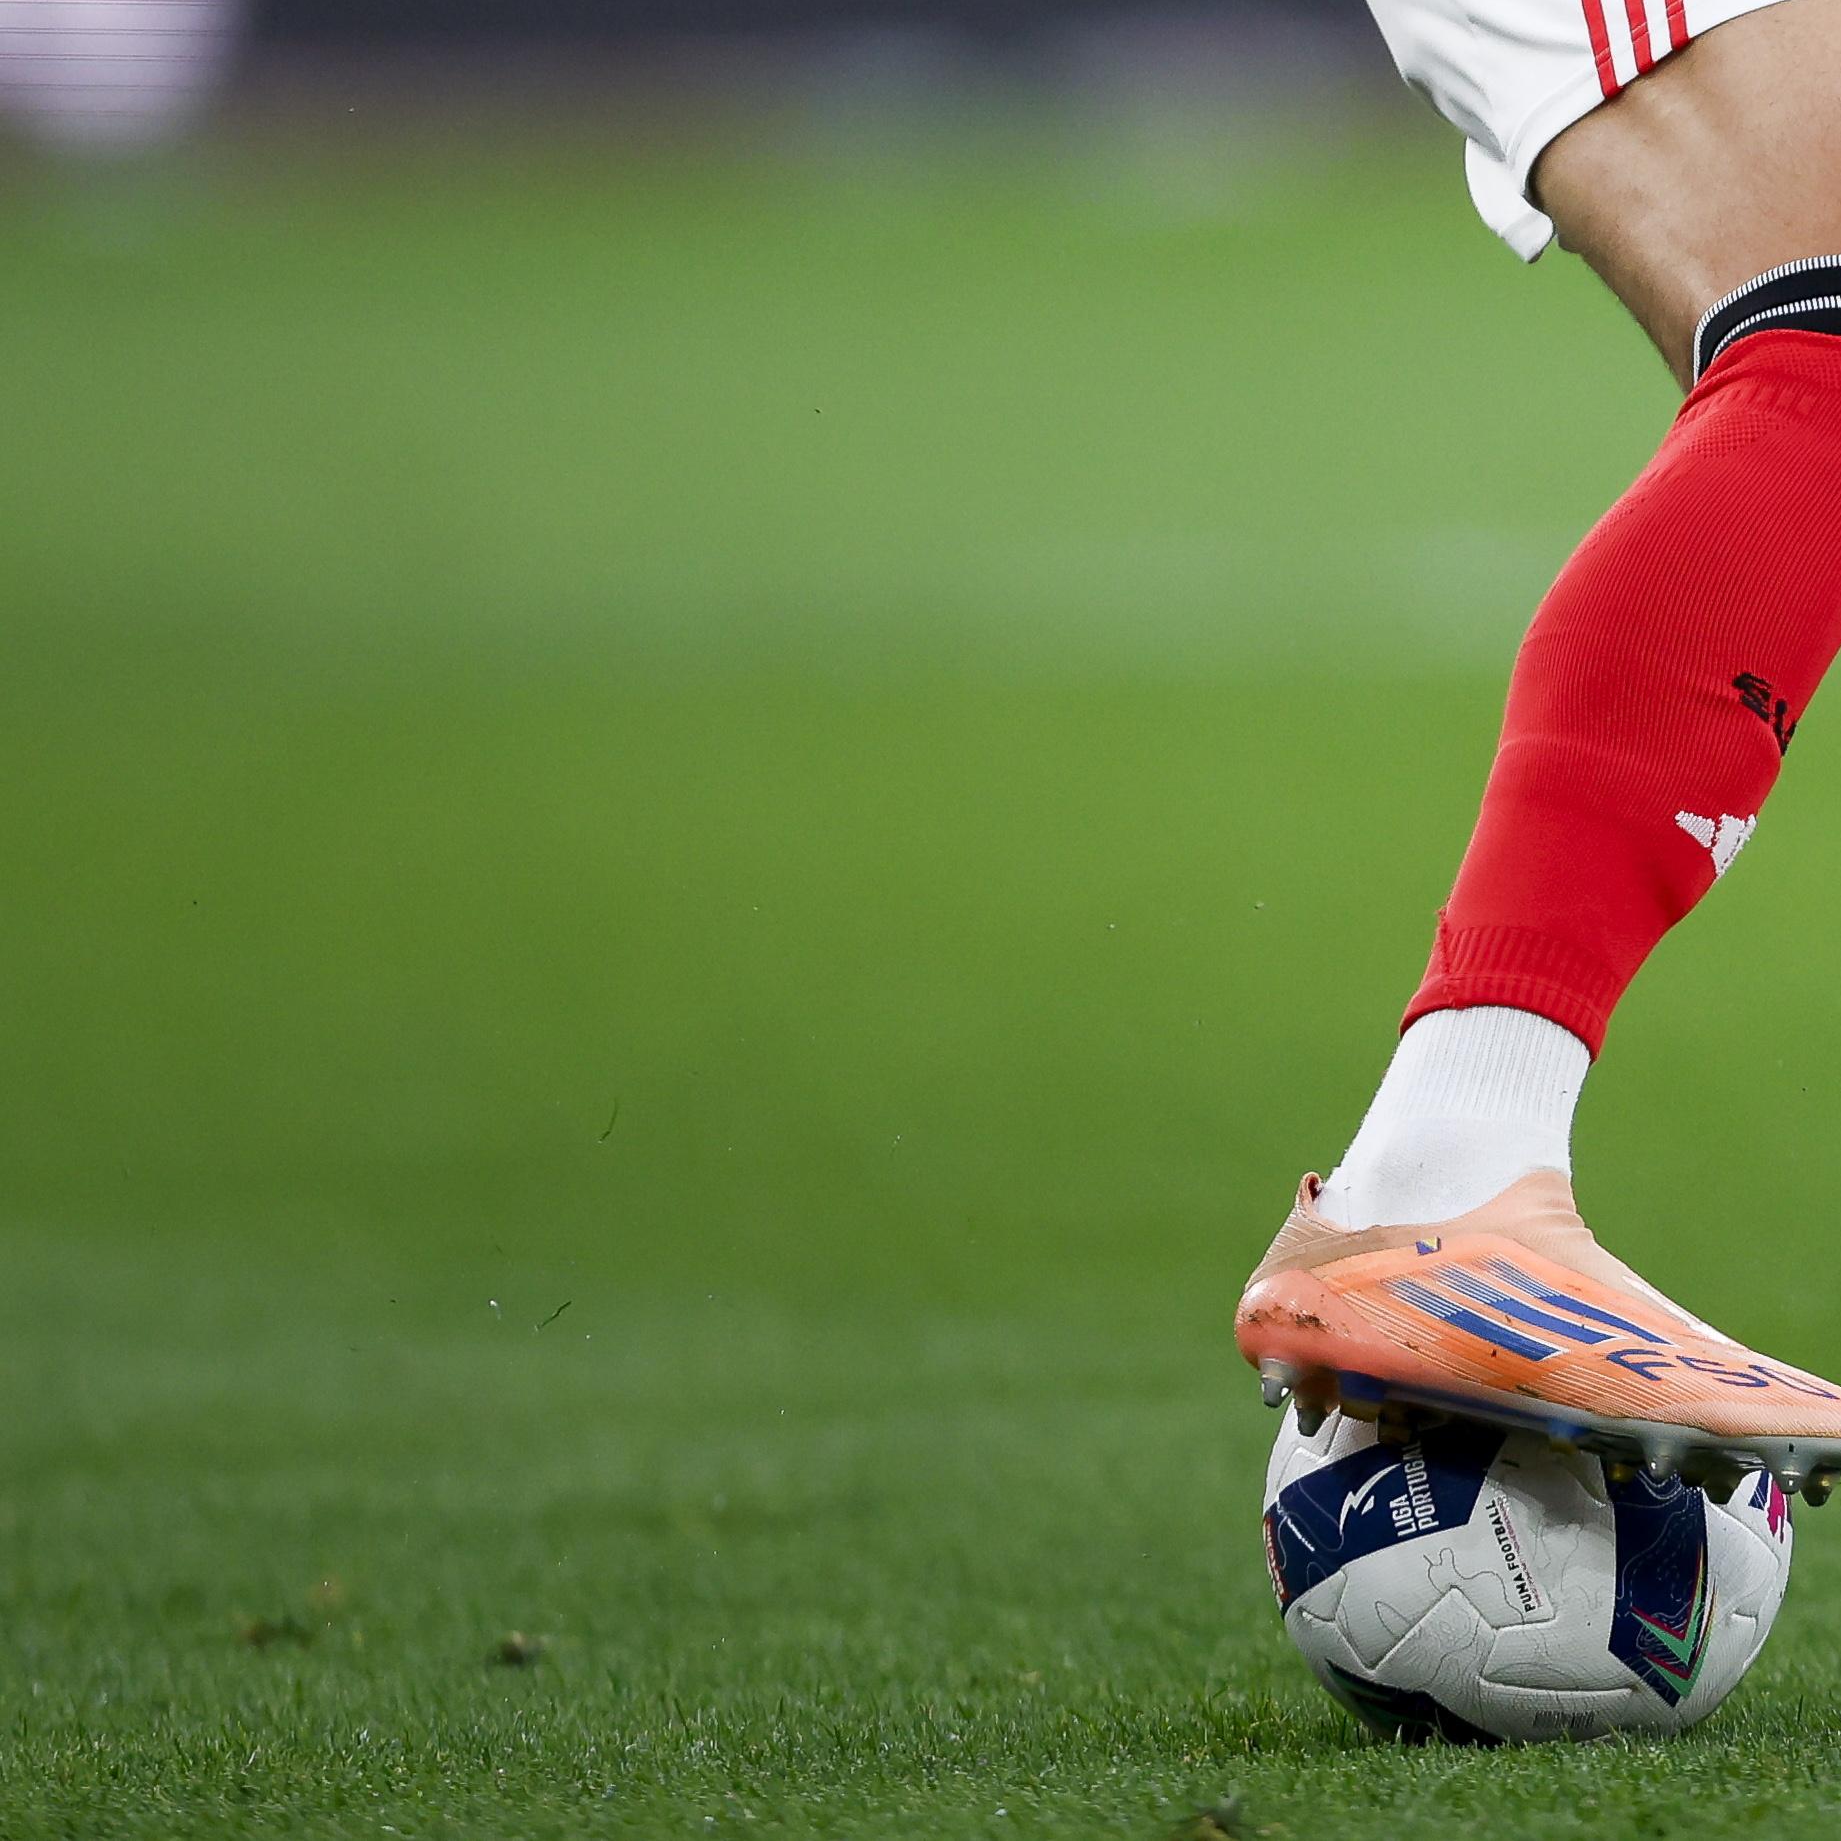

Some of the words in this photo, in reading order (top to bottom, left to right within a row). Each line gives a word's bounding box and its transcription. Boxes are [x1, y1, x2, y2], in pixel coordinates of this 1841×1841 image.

[1605, 1348, 1840, 1400] F50
[1401, 1439, 1440, 1531] PORTUGAL
[1389, 1493, 1418, 1538] LIGA
[1485, 1499, 1520, 1571] FOOTBALL
[1513, 1572, 1537, 1613] PUMA
